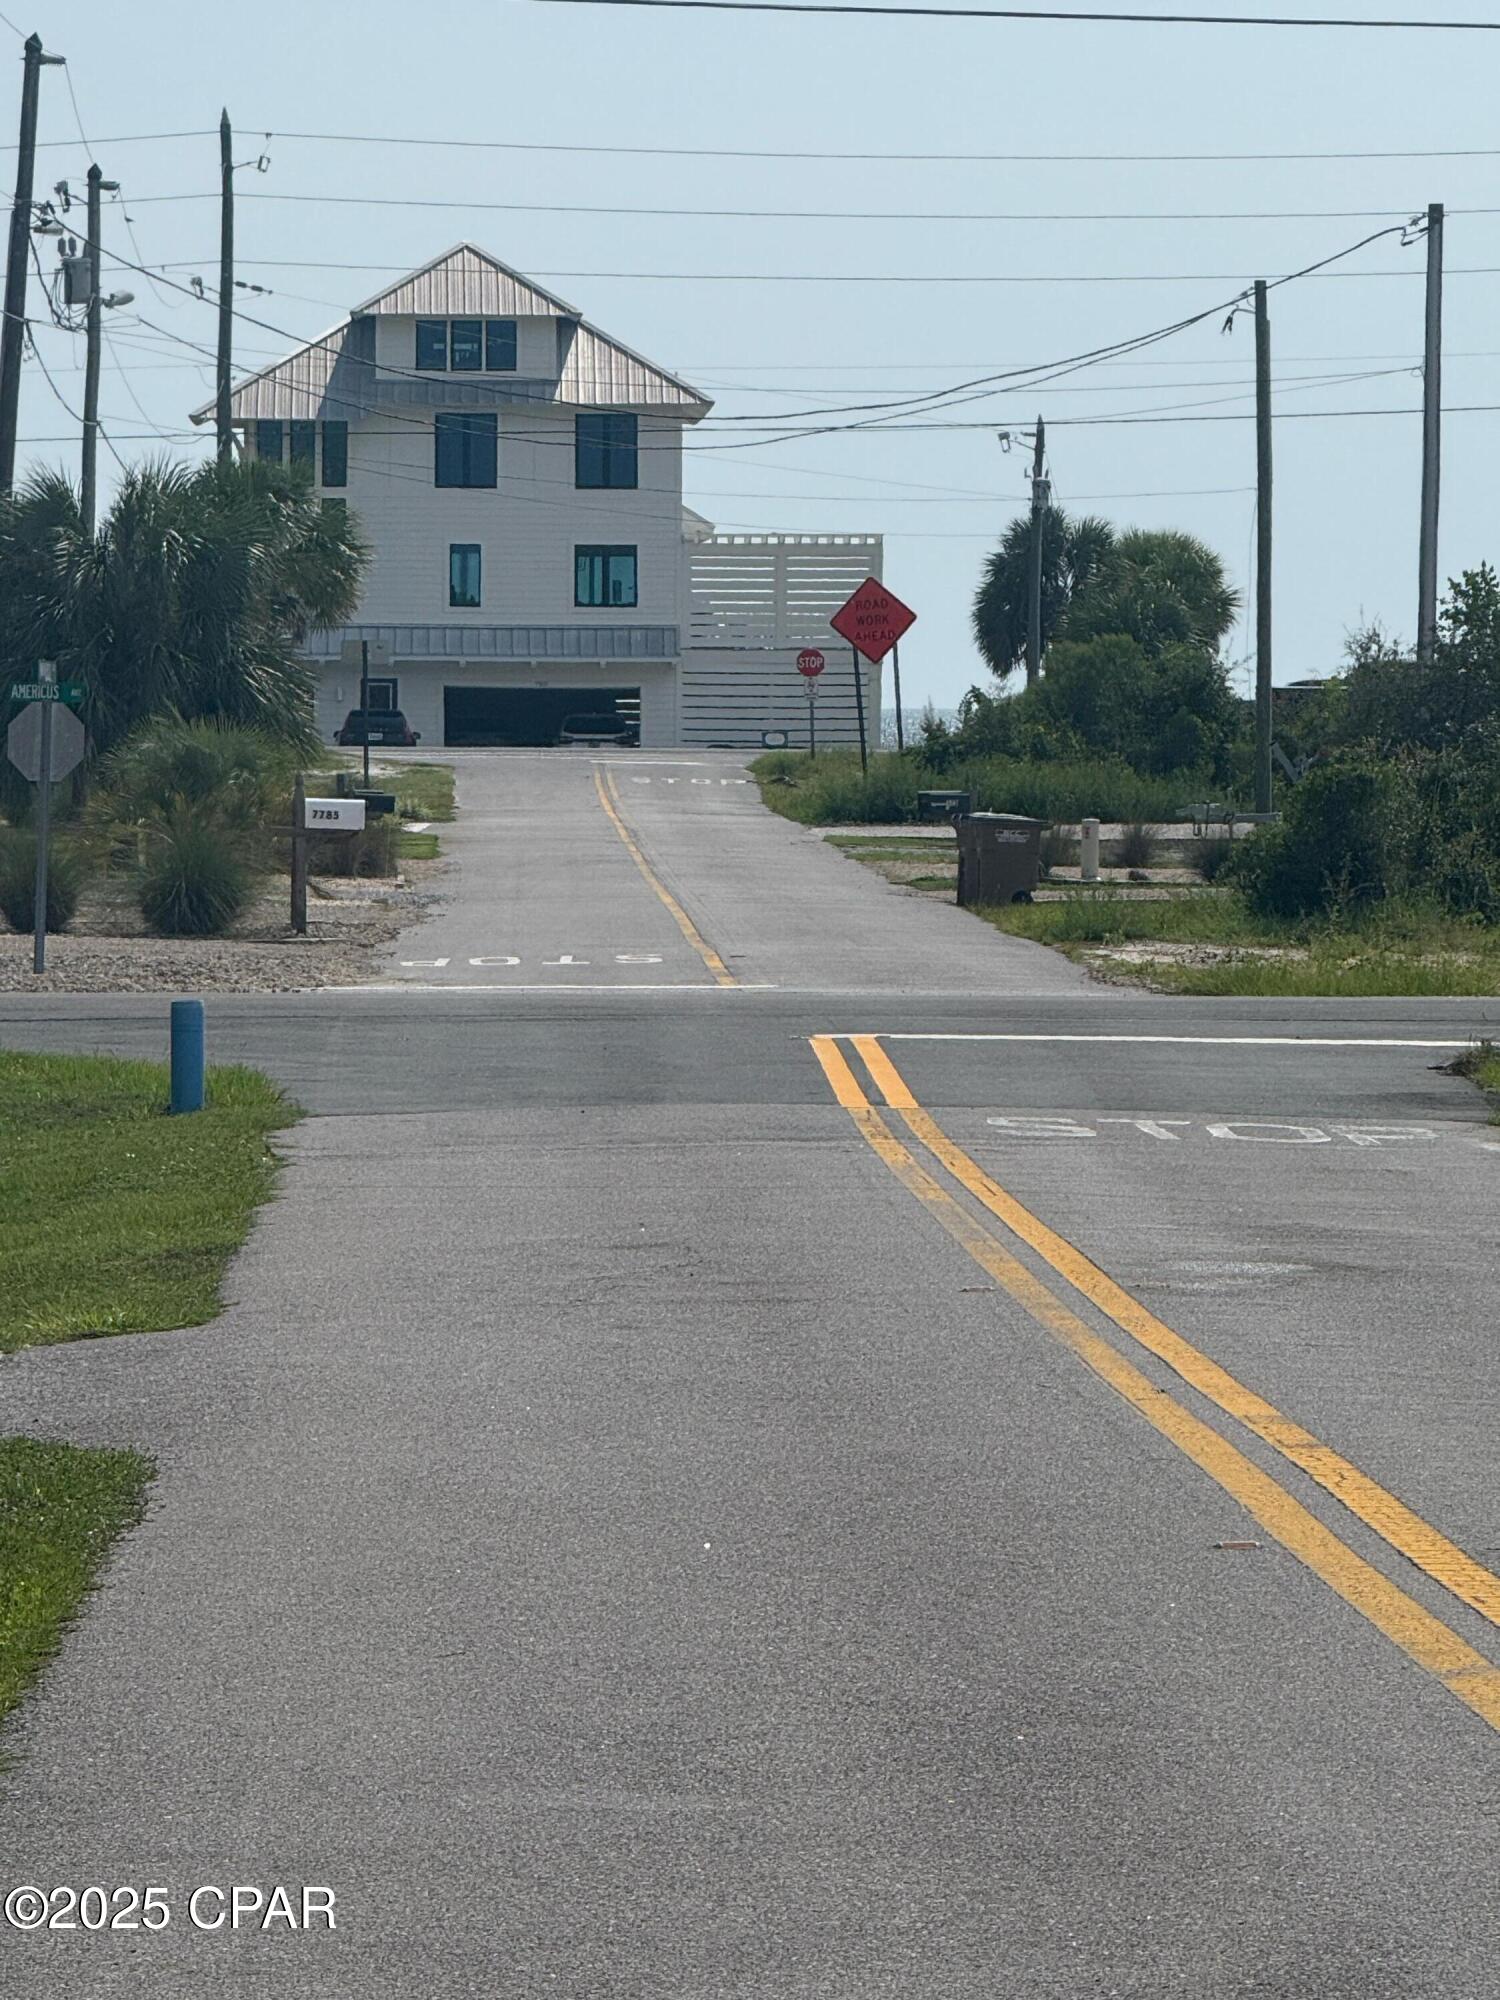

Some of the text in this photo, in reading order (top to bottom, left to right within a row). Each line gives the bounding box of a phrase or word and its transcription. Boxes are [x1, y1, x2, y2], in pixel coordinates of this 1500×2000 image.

[855, 599, 889, 611] ROAD
[856, 615, 889, 626] WORK
[855, 630, 896, 642] AHEAD
[798, 656, 823, 668] STOP
[11, 684, 59, 699] AMERICUS
[312, 810, 339, 820] 7785
[399, 953, 663, 967] STOP
[985, 1116, 1441, 1147] STOP
